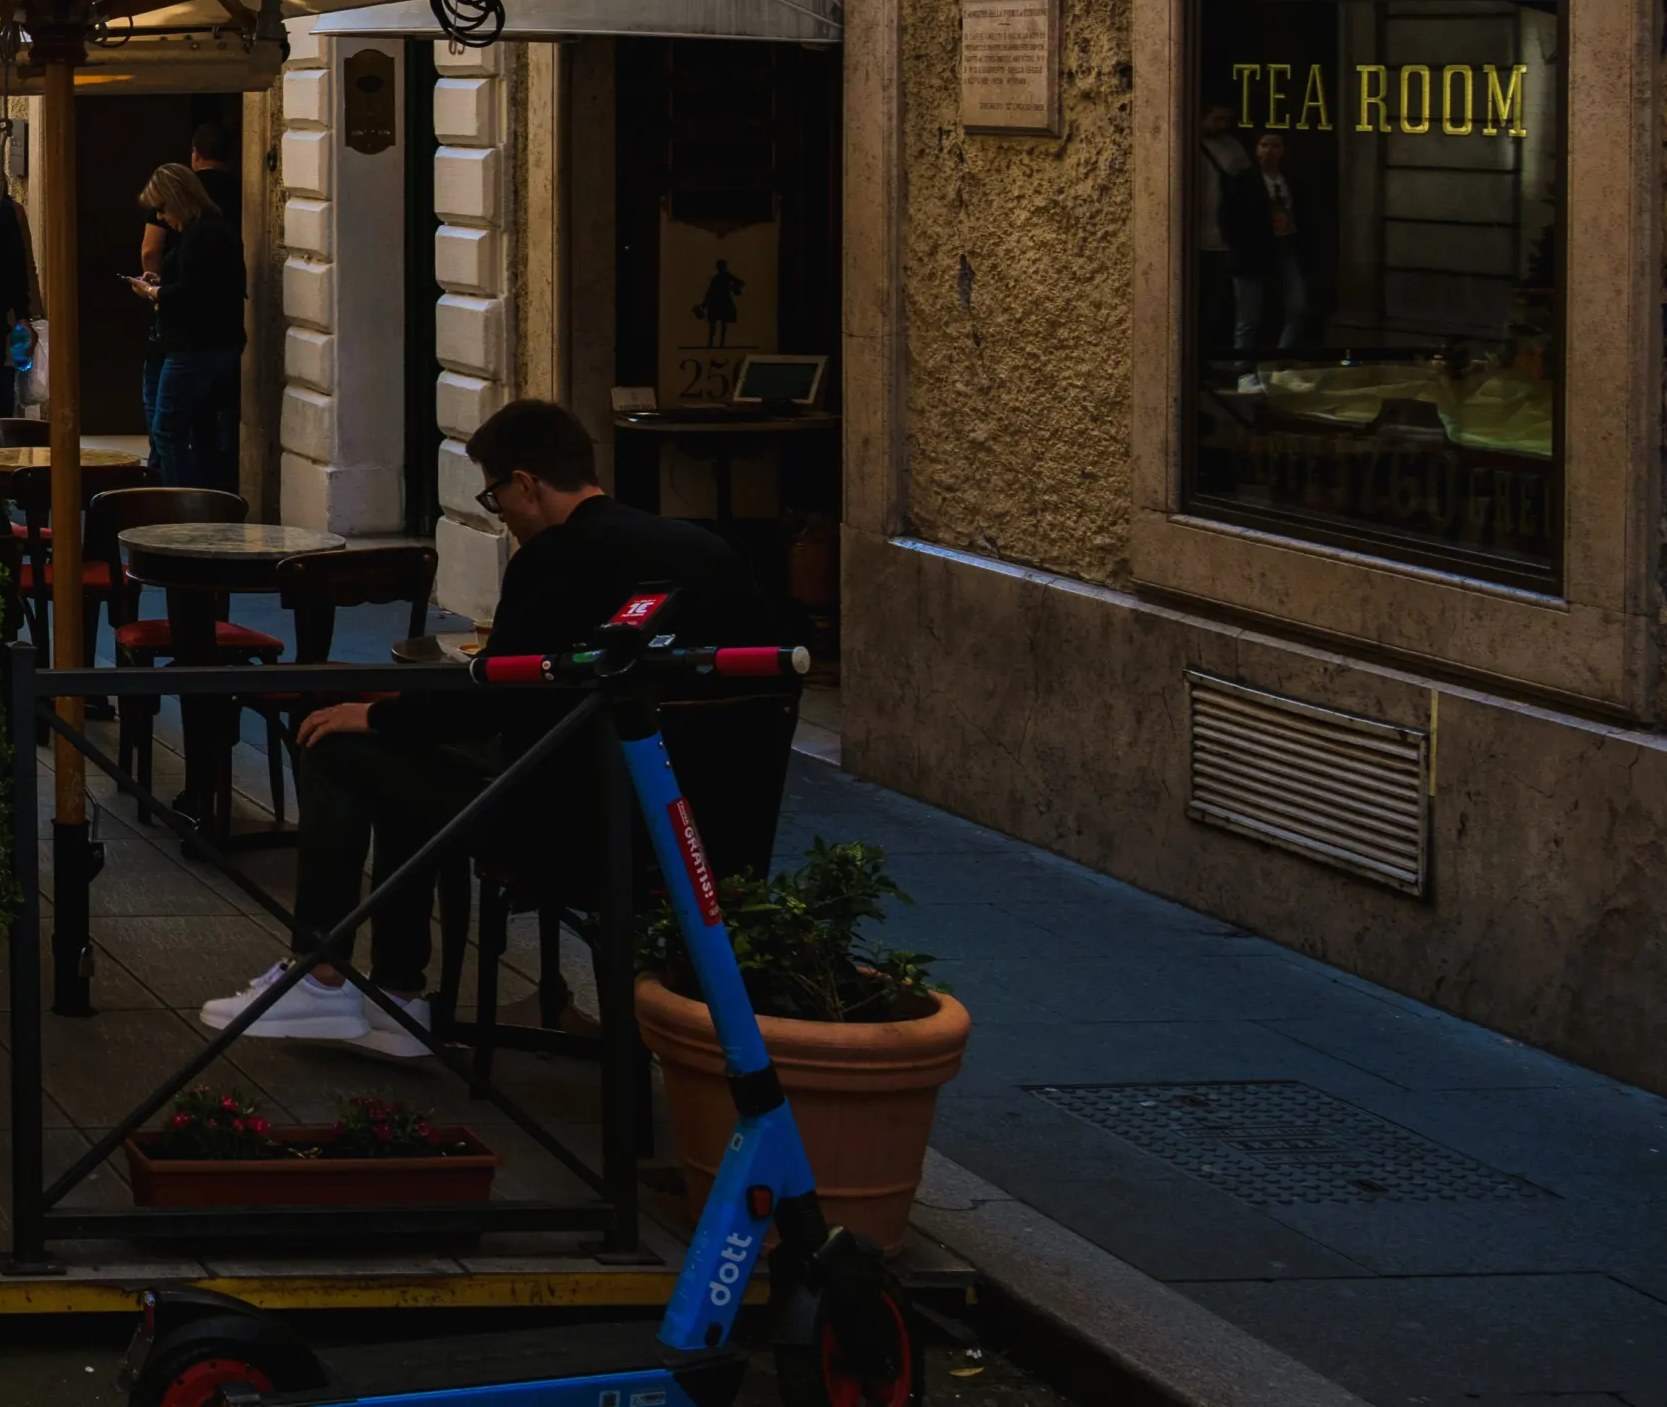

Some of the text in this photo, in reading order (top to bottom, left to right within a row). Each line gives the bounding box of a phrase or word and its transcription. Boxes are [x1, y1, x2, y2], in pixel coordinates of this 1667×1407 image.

[1233, 64, 1528, 138] TEA ROOM
[684, 826, 714, 898] GRATIS!
[709, 1232, 753, 1306] dott
